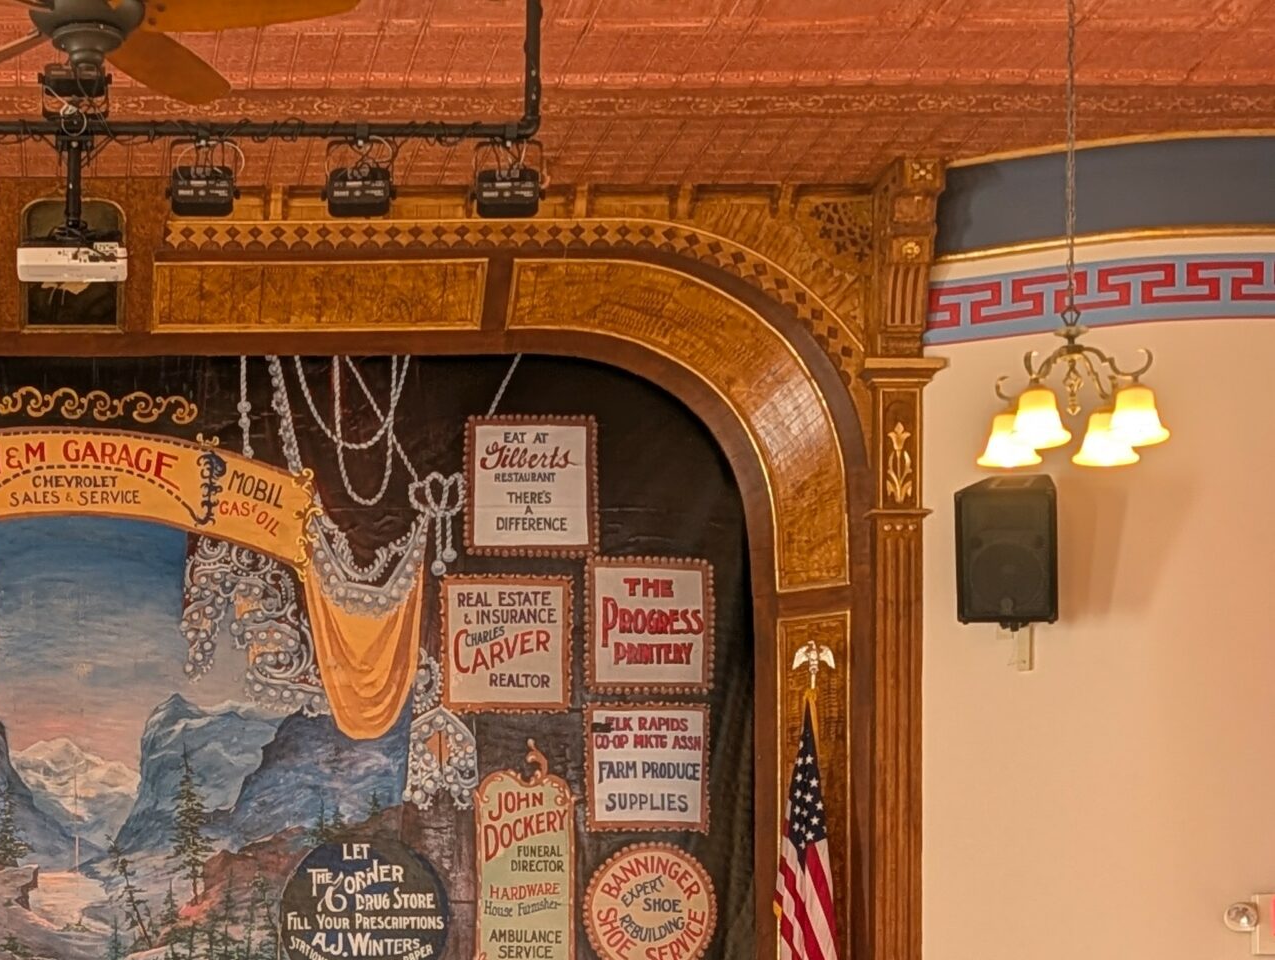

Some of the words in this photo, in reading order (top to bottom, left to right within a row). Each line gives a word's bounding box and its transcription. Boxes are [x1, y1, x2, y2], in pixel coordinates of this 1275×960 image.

[503, 432, 527, 444] EAT
[532, 432, 549, 444] AT
[63, 439, 180, 492] GARAGE
[32, 475, 118, 489] CHEVROLET
[494, 472, 556, 483] RESTAURANT
[9, 491, 60, 507] SALES
[65, 492, 74, 503] &
[77, 489, 141, 506] SERVICE
[227, 469, 283, 510] MOBIL
[506, 490, 552, 505] THERE'S
[219, 499, 251, 516] GAS
[255, 510, 278, 537] OIL
[524, 505, 534, 516] A
[496, 516, 568, 532] DIFFERENCE
[623, 577, 674, 598] THE
[457, 591, 493, 608] REAL
[498, 591, 552, 607] ESTATE
[463, 613, 473, 625] &
[476, 608, 557, 625] INSURANCE
[601, 596, 705, 648] PROGRESS
[465, 625, 505, 648] CHARLES
[453, 628, 551, 675] CARVER
[613, 641, 694, 666] PRINTERY
[489, 672, 551, 689] REALTOR
[605, 716, 634, 732] ELK
[638, 716, 689, 732] RAPIDS
[594, 733, 629, 750] CO-OP
[633, 733, 668, 749] MKTG
[671, 735, 702, 752] ASSN
[597, 761, 638, 785] FARM
[641, 761, 701, 782] PRODUCE
[488, 791, 544, 822] JOHN
[605, 793, 689, 813] SUPPLIES
[484, 809, 568, 863] DOCKERY
[342, 843, 371, 861] LET
[517, 845, 563, 858] FUNERAL
[510, 859, 565, 873] DIRECTOR
[306, 867, 334, 897] THE
[600, 855, 701, 901] BANNINGER
[355, 892, 391, 911] DRUG
[393, 887, 436, 910] STORE
[489, 882, 561, 901] HARDWARE
[620, 874, 665, 908] EXPERT
[483, 899, 514, 918] House
[642, 897, 683, 914] SHOE
[287, 911, 312, 931] FILL
[316, 913, 350, 930] YOUR
[354, 914, 445, 930] PRESCRIPTIONS
[619, 913, 686, 943] REBUILDING
[347, 932, 421, 957] WINTERS
[489, 928, 563, 945] AMBULANCE
[497, 945, 555, 960] SERVICE
